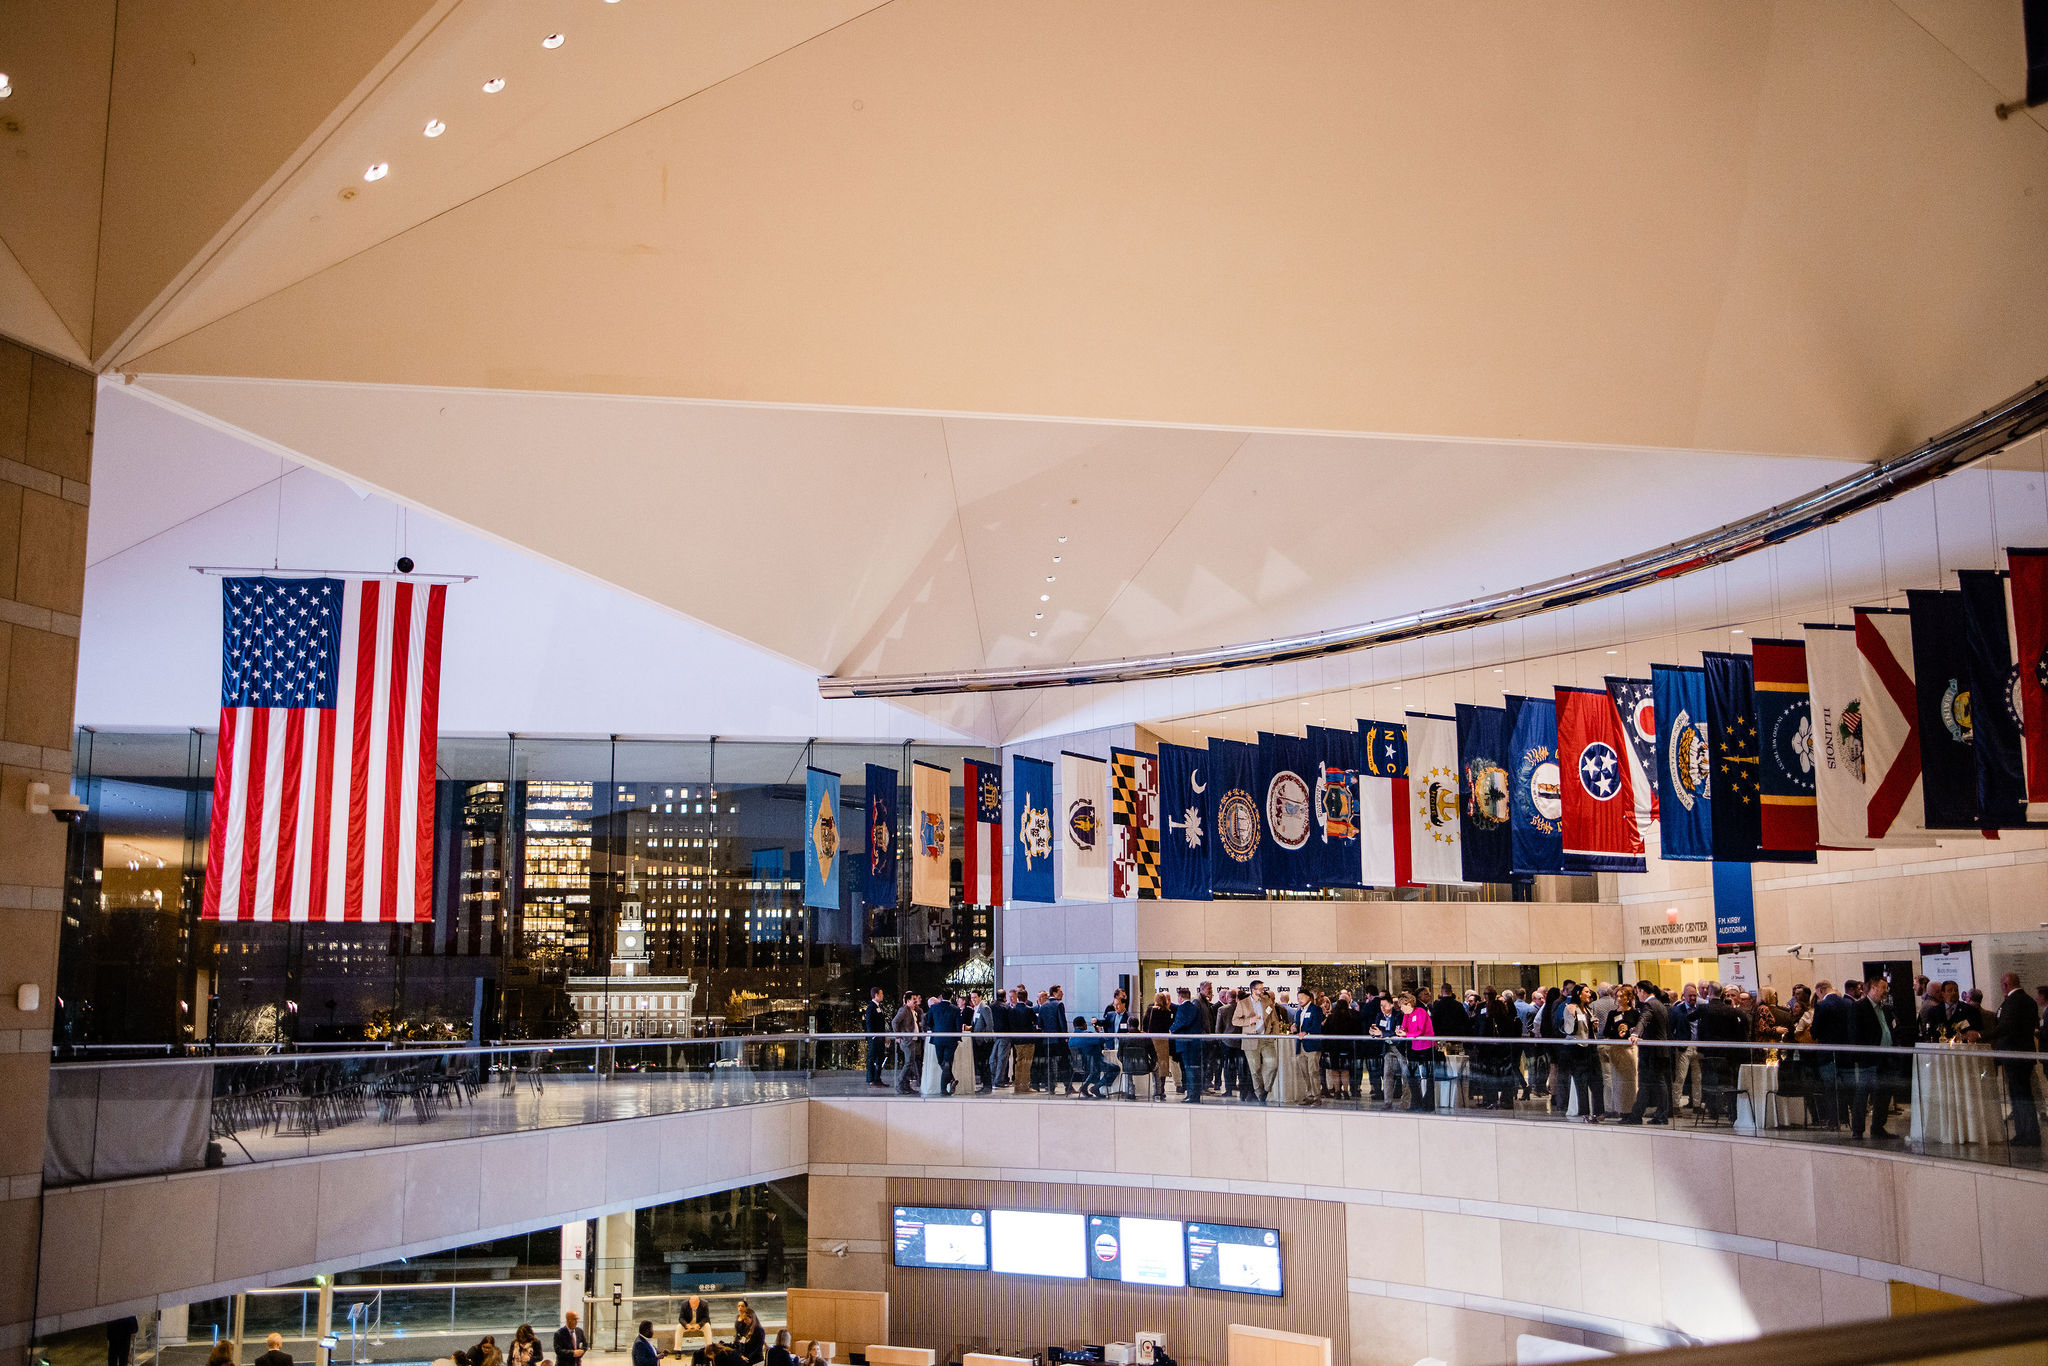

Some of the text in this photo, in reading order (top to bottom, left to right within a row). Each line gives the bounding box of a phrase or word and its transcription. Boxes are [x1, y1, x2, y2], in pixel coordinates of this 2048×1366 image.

[1824, 708, 1836, 769] ILLINOIS
[1384, 730, 1397, 774] N C
[1773, 750, 1785, 771] TRUST
[1727, 916, 1741, 924] KIRBY
[1639, 922, 1708, 935] THE ANNENBERG CENTER
[1719, 926, 1747, 934] AUDITORIUM
[1650, 937, 1673, 945] EDUCATION
[1684, 935, 1707, 944] OUTREACH
